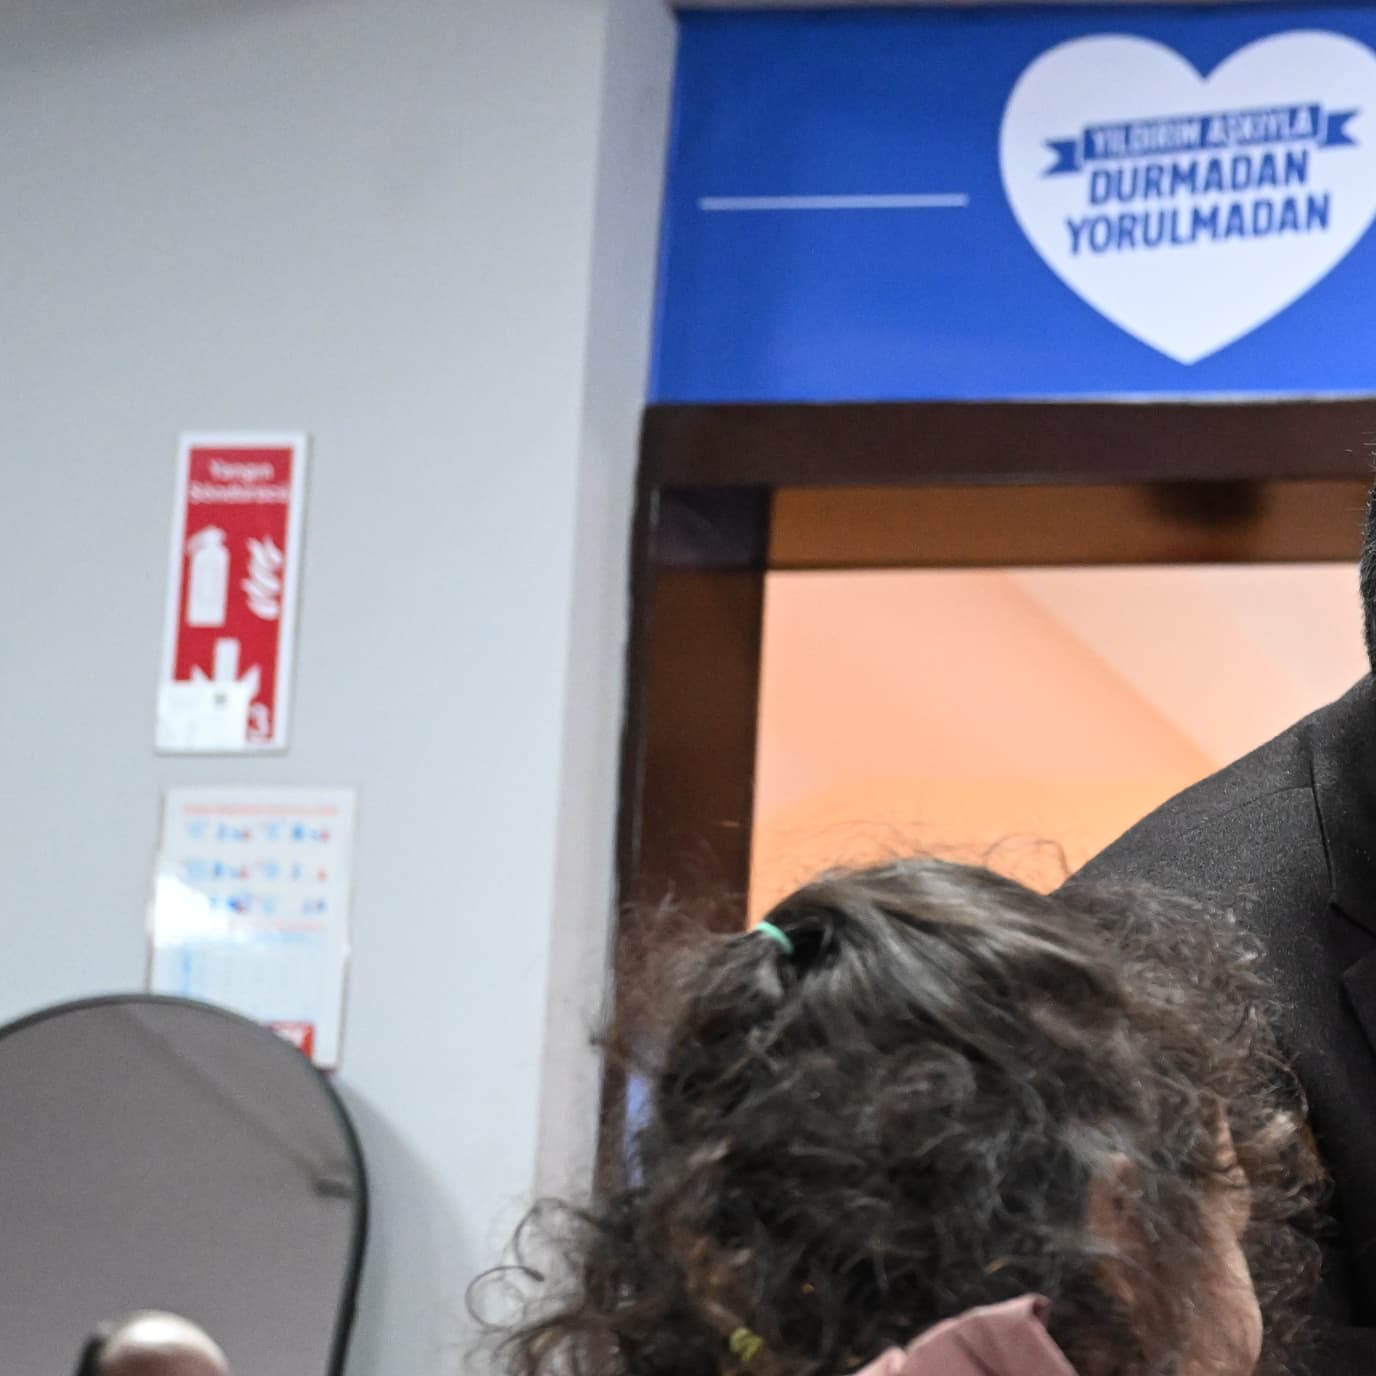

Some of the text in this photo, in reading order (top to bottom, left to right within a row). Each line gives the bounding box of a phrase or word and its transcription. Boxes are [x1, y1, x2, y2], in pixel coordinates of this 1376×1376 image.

[1090, 118, 1201, 157] YILDIRIM
[1089, 149, 1309, 206] DURMADAN
[1066, 193, 1331, 255] YORULMADAN
